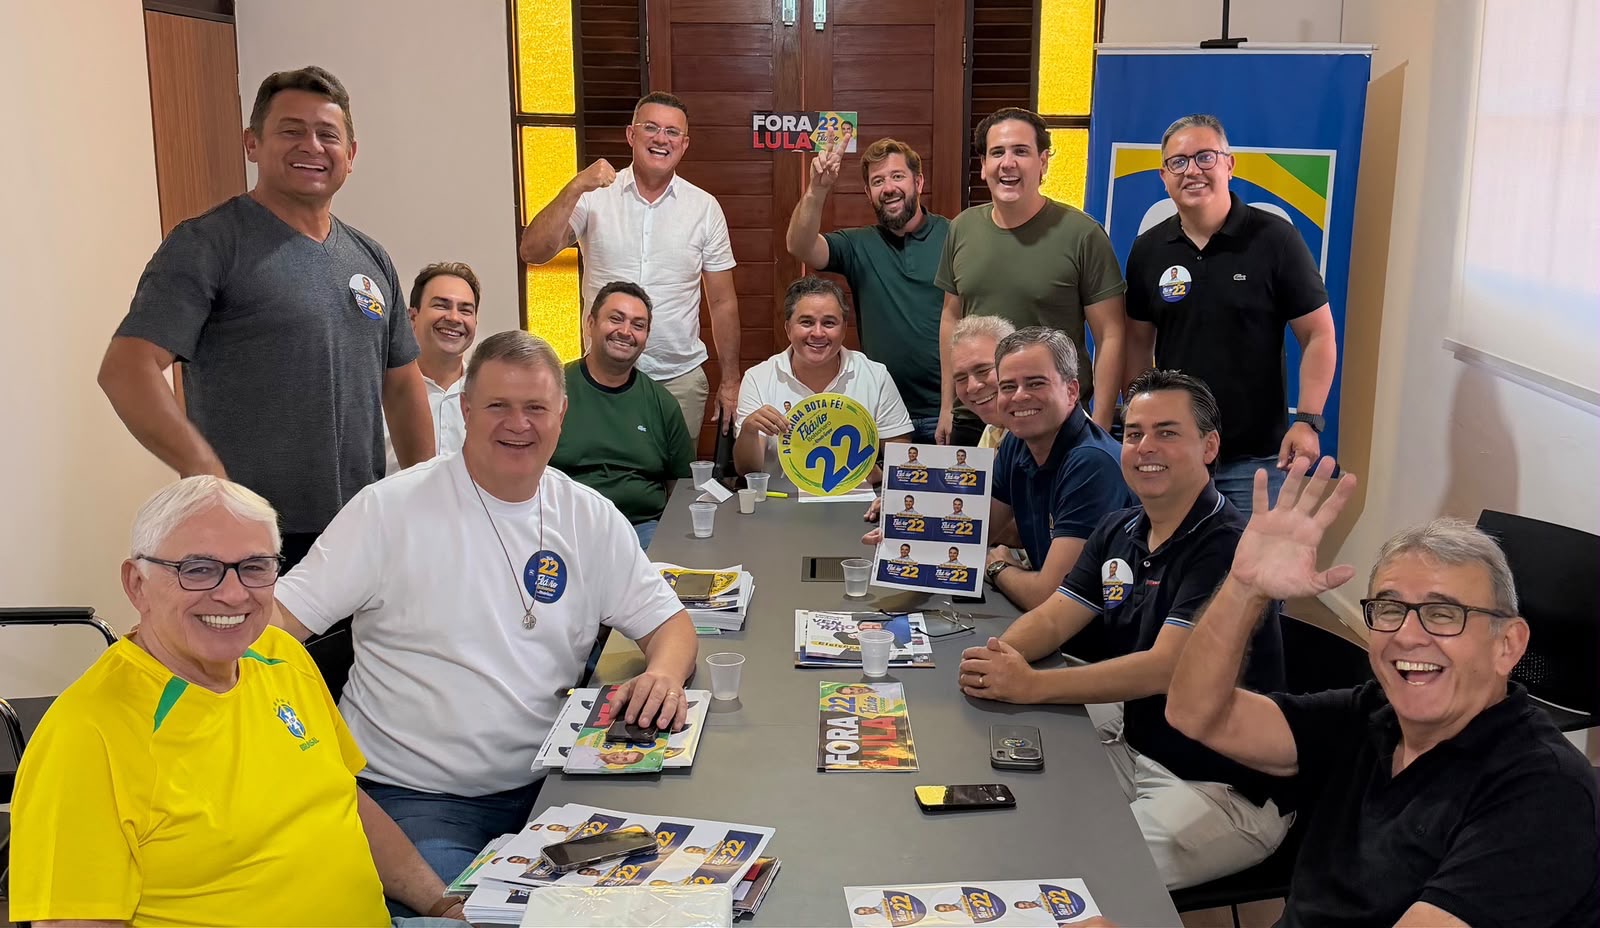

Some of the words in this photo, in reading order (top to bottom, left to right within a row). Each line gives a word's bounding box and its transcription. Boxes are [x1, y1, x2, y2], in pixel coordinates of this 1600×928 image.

[753, 115, 813, 132] FORA
[818, 117, 839, 131] 22
[753, 132, 813, 149] LULA
[1172, 285, 1186, 296] 22
[804, 399, 828, 413] BOTA
[830, 397, 844, 409] FÉ!
[797, 412, 828, 441] Flávio
[806, 424, 876, 493] 22
[910, 470, 928, 483] 22
[959, 473, 977, 486] 22
[907, 519, 925, 532] 22
[955, 522, 973, 535] 22
[538, 559, 559, 577] 22
[900, 566, 919, 578] 22
[949, 569, 968, 582] 22
[1108, 587, 1124, 600] 22
[828, 697, 856, 712] 22
[825, 716, 859, 765] FORA
[861, 717, 899, 766] LULA
[721, 840, 745, 857] 22
[615, 865, 642, 880] 22
[891, 895, 913, 911] 22
[969, 892, 993, 909] 22
[1048, 890, 1072, 906] 22
